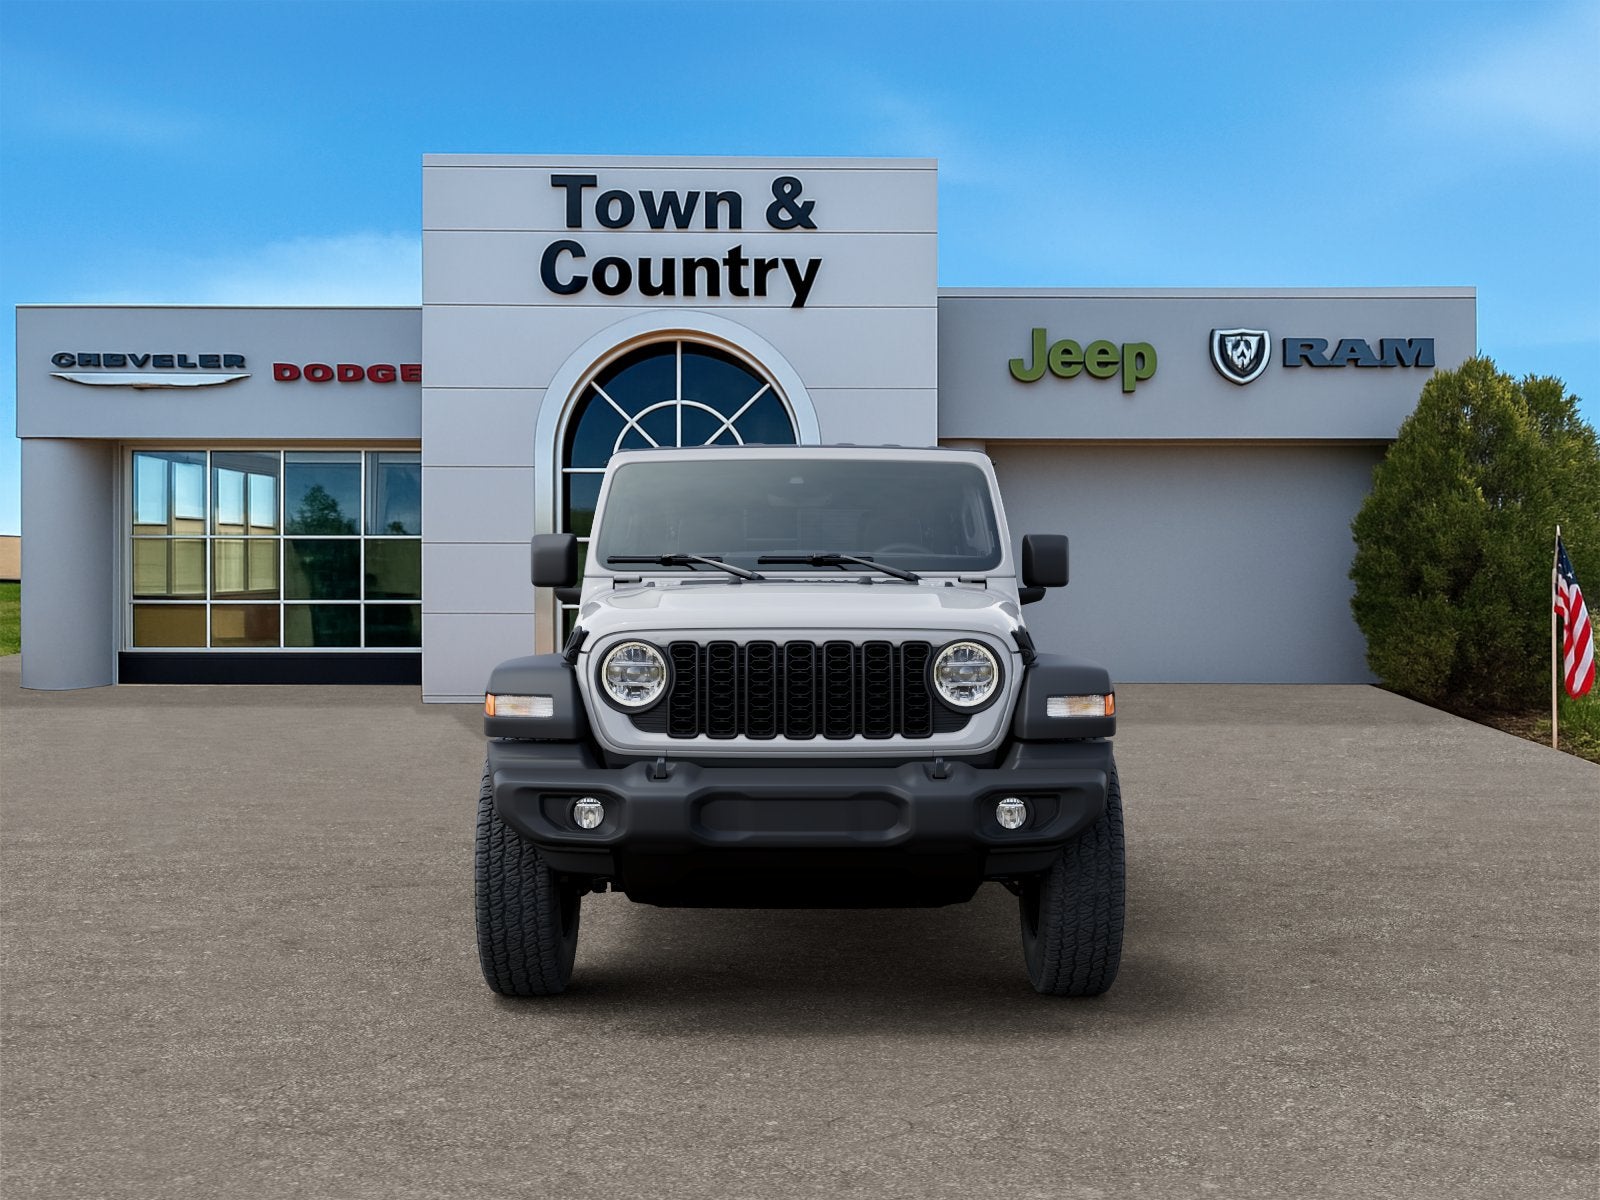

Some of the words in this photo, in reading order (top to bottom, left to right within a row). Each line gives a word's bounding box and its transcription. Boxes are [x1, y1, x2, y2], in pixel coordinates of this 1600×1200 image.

[550, 174, 743, 229] Town
[766, 175, 818, 230] &
[540, 239, 823, 308] Country
[273, 363, 422, 383] DODGE
[1009, 328, 1157, 393] Jeep
[1283, 337, 1435, 367] RAM
